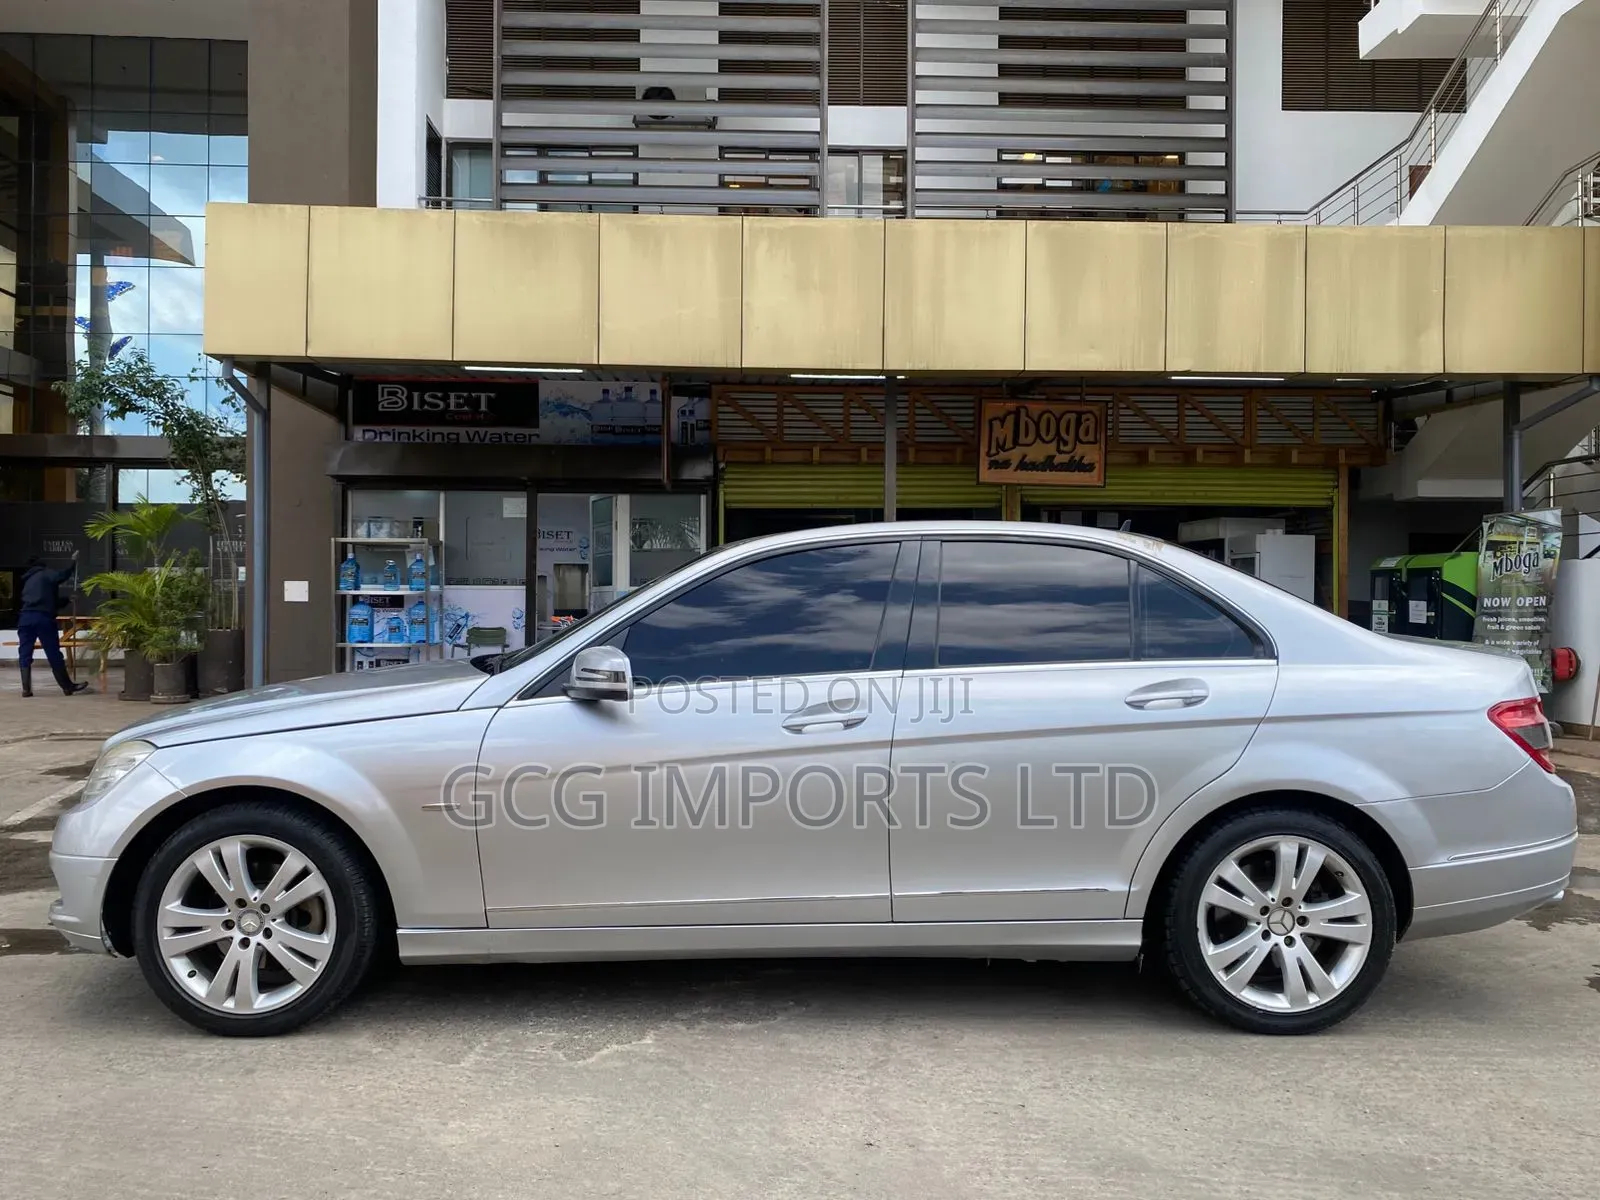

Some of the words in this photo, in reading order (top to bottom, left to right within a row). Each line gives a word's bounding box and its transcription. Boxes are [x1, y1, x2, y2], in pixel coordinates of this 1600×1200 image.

[377, 383, 497, 412] BISET
[362, 428, 460, 445] Drinking
[464, 429, 540, 445] Water
[986, 405, 1098, 457] Mboga
[1489, 551, 1540, 582] Mboga
[1483, 597, 1511, 607] NOW
[1516, 596, 1547, 607] OPEN
